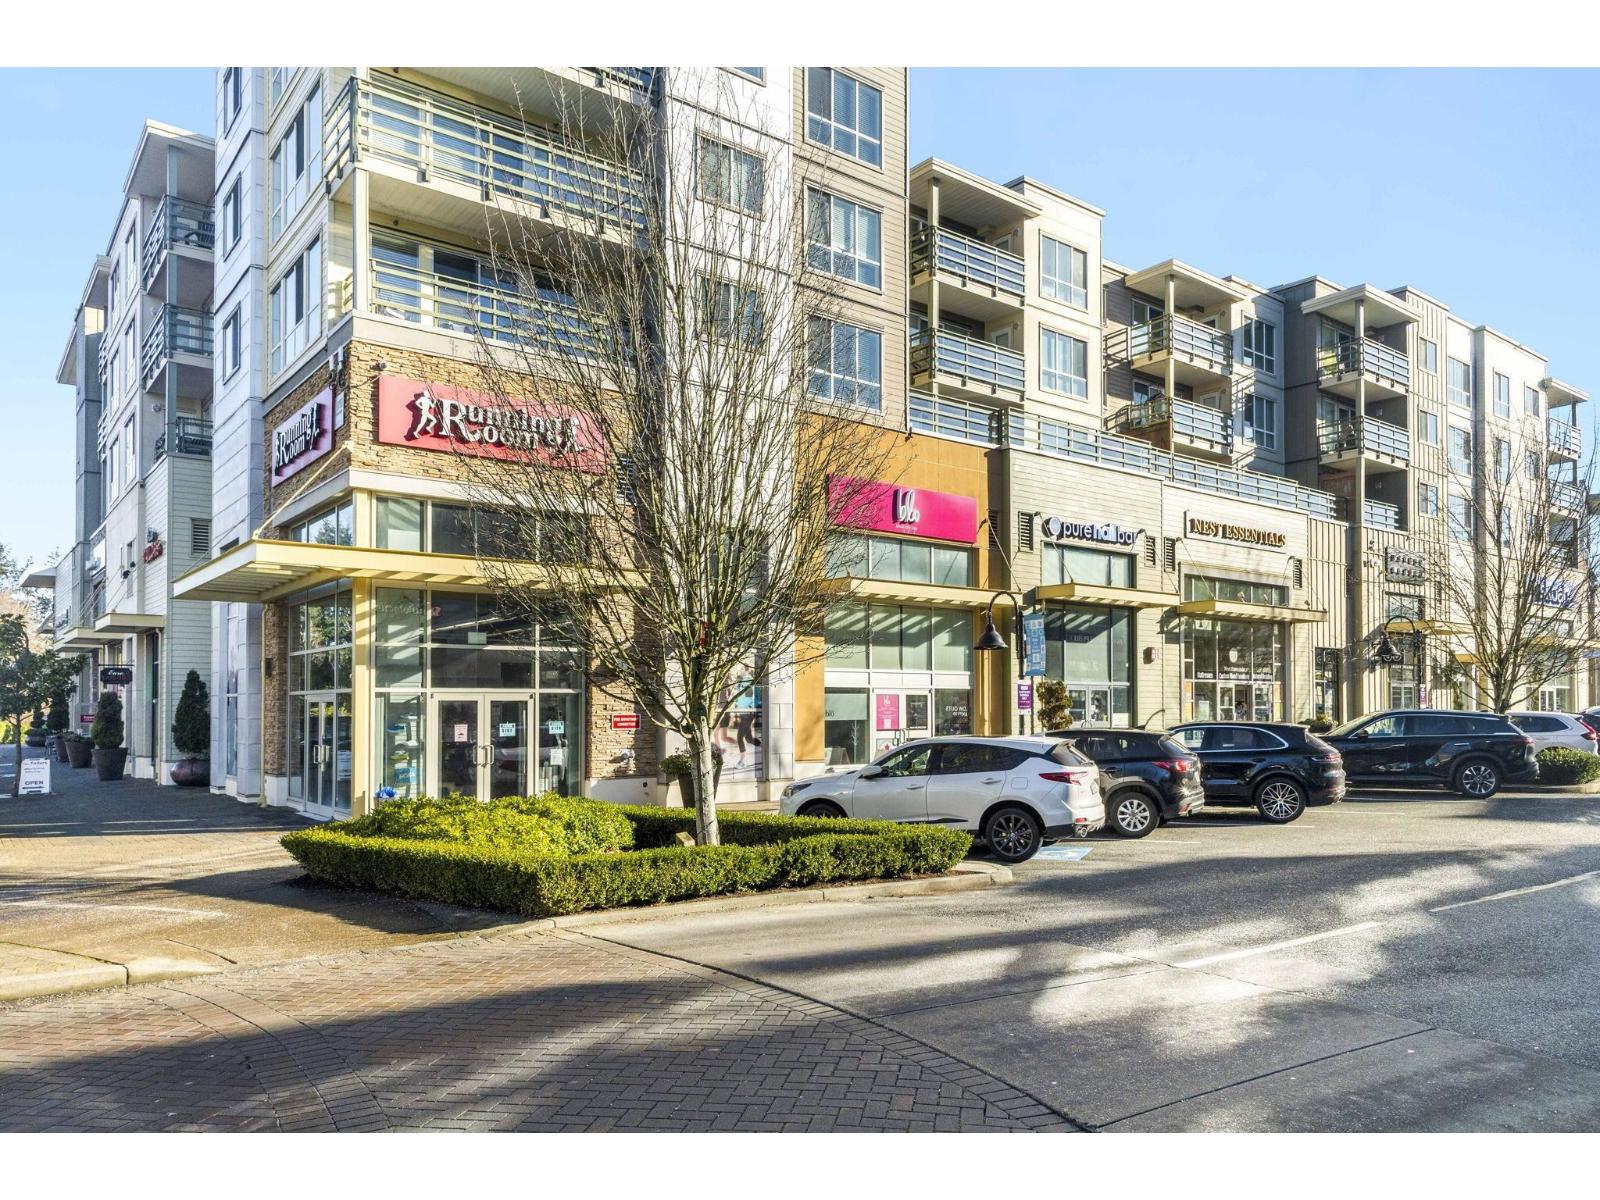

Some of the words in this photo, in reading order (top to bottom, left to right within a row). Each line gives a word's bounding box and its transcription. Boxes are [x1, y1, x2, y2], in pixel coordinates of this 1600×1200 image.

[280, 410, 312, 466] Running
[439, 398, 562, 447] Running
[897, 488, 920, 522] blo
[1065, 521, 1092, 540] pure
[1092, 521, 1116, 542] nail
[1193, 519, 1223, 536] NEST
[1227, 525, 1286, 547] ESSENTIALS
